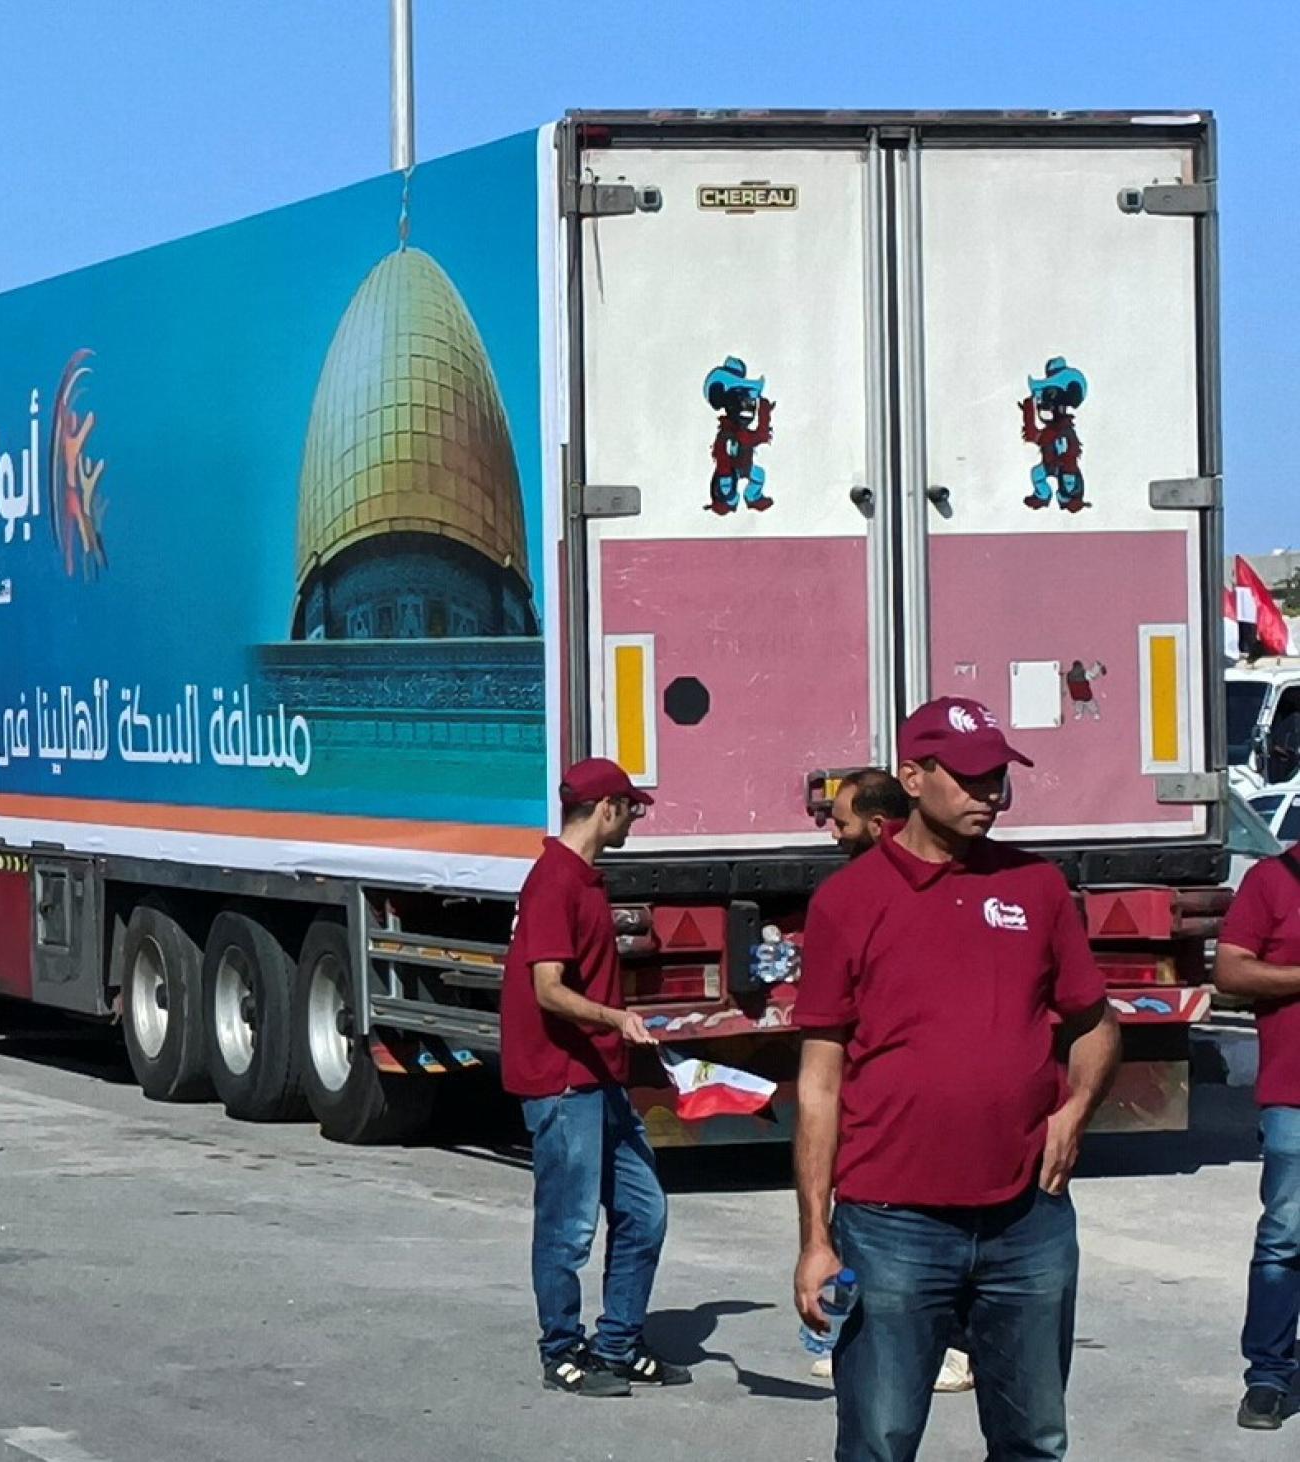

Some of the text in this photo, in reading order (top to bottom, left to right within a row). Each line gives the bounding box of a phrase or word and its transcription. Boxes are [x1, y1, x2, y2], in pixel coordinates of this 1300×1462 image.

[701, 188, 794, 206] CHEREAU
[118, 683, 201, 765] السكة
[209, 683, 311, 776] مسافة
